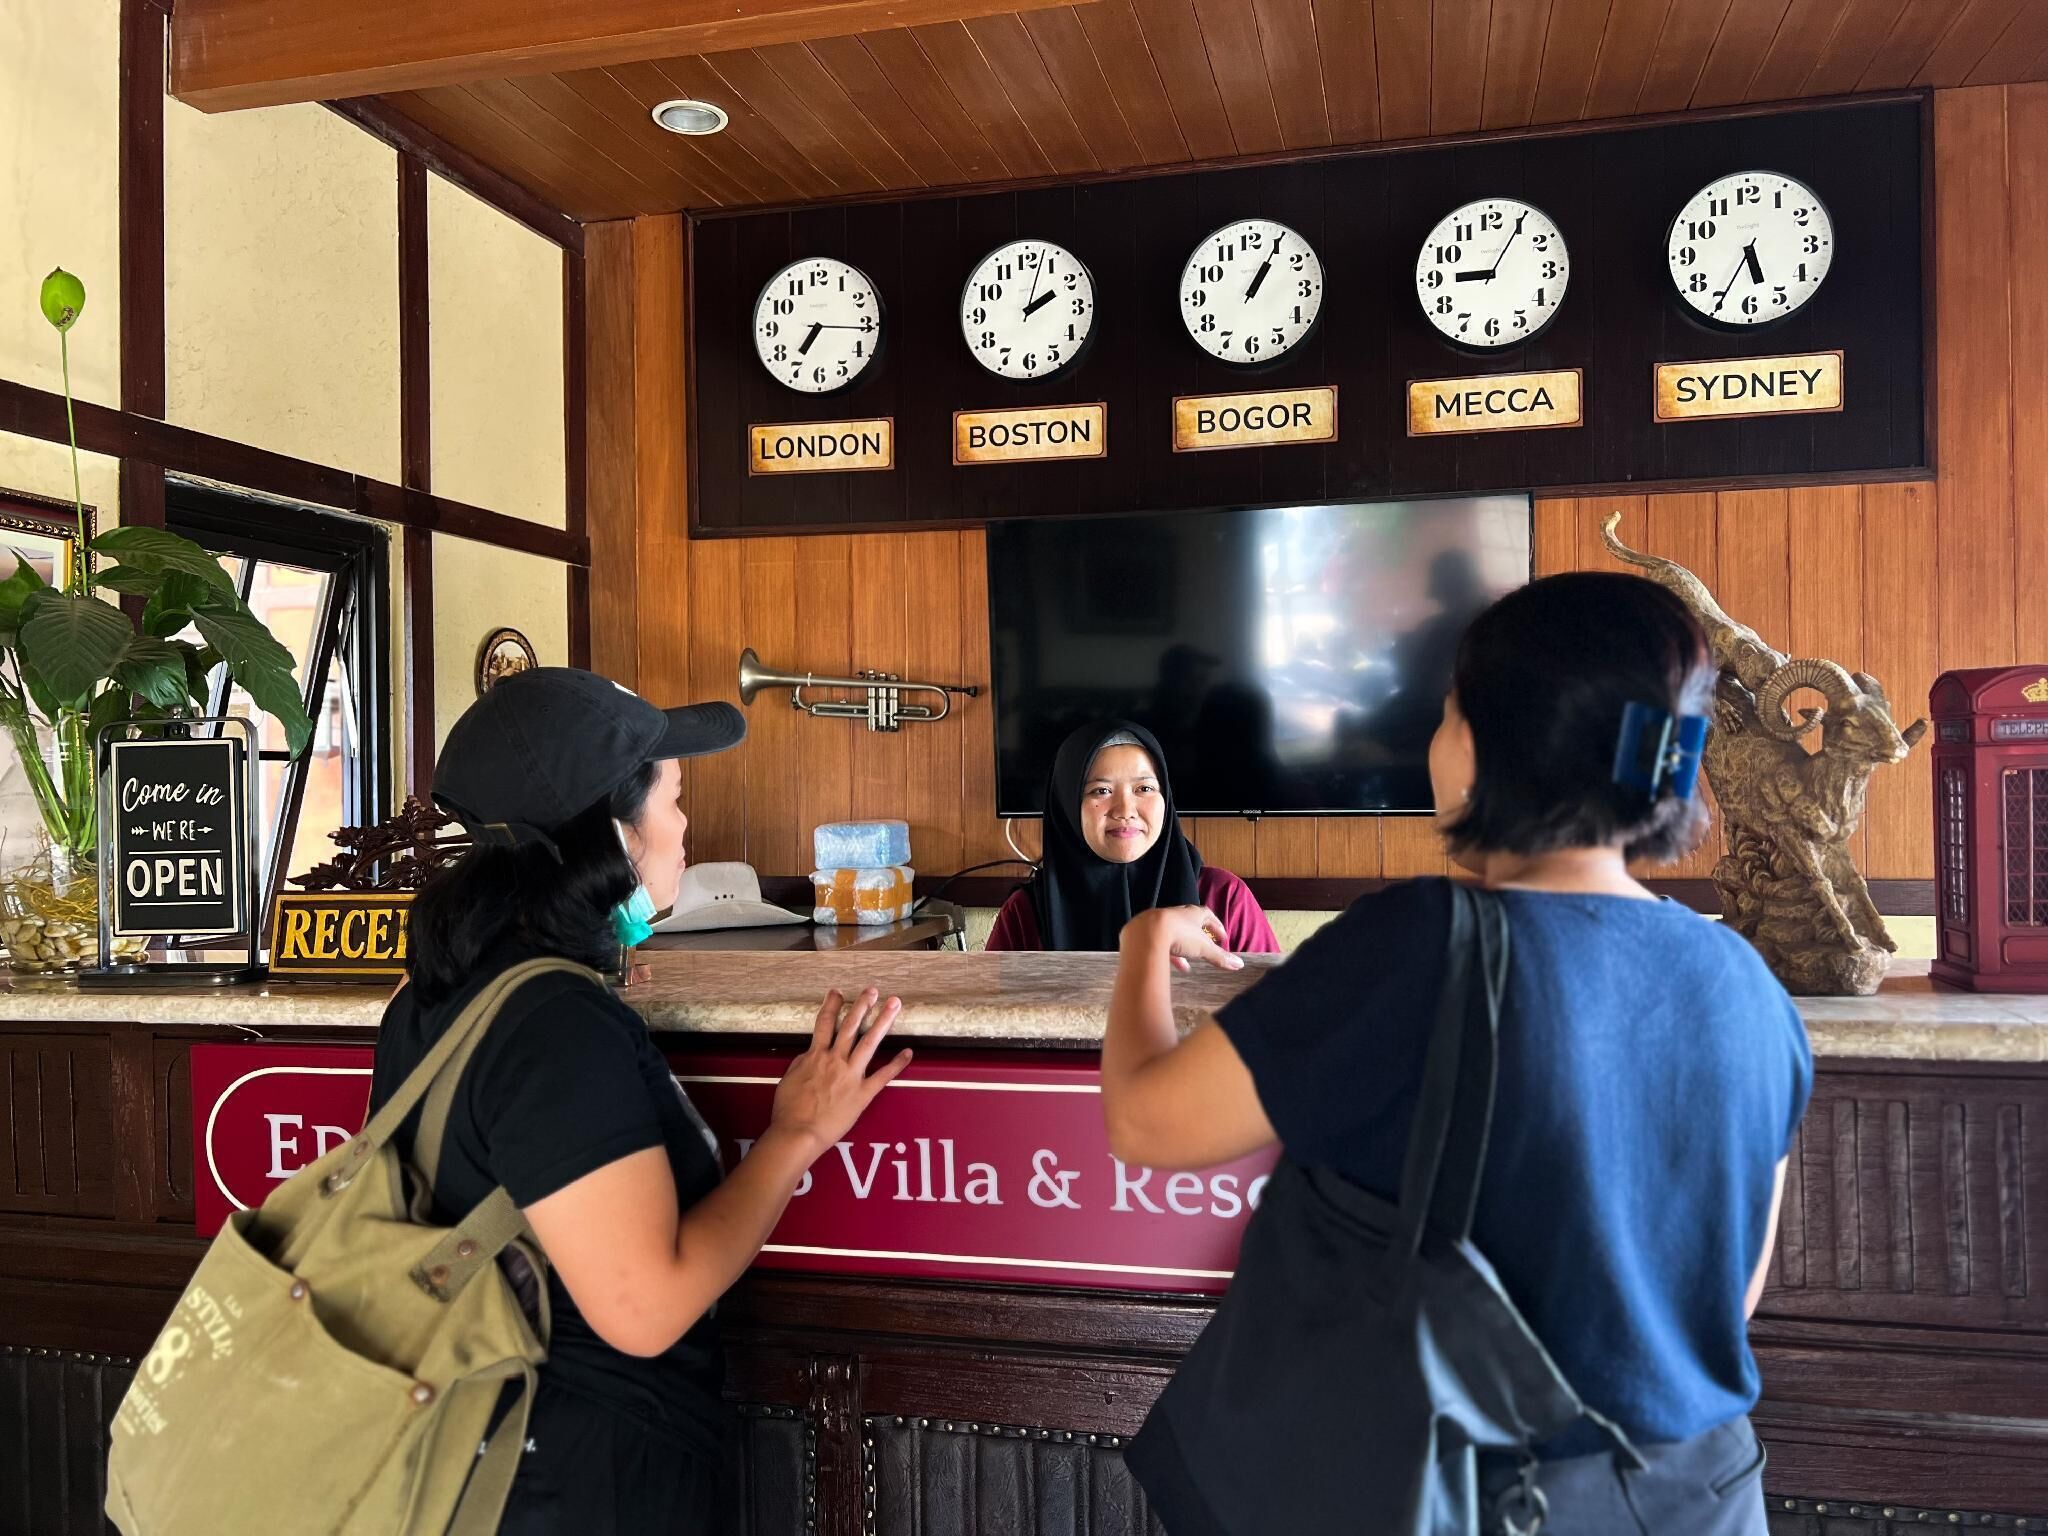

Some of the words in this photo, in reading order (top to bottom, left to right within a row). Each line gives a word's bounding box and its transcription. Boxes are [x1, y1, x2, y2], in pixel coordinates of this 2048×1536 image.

[1736, 185, 1761, 206] 12
[1774, 190, 1782, 209] 1
[1709, 198, 1728, 217] 11
[1480, 211, 1503, 231] 12
[1793, 208, 1809, 227] 2
[1455, 223, 1473, 242] 11
[1689, 220, 1716, 241] 10
[1240, 233, 1262, 251] 12
[1532, 234, 1548, 252] 2
[1803, 235, 1819, 254] 3
[1017, 252, 1038, 270] 12
[1218, 244, 1234, 262] 11
[1436, 244, 1462, 264] 10
[1679, 246, 1696, 266] 9
[997, 264, 1011, 280] 11
[1048, 258, 1054, 274] 1
[1289, 254, 1303, 272] 2
[1542, 261, 1557, 279] 3
[1792, 263, 1808, 282] 4
[809, 270, 829, 286] 12
[1063, 274, 1076, 290] 2
[1200, 264, 1224, 283] 10
[1427, 270, 1443, 289] 9
[1689, 272, 1708, 292] 8
[789, 280, 804, 296] 11
[839, 276, 844, 292] 1
[980, 284, 1002, 301] 10
[1298, 280, 1312, 297] 3
[852, 292, 865, 308] 2
[1192, 290, 1206, 307] 9
[1436, 295, 1453, 314] 8
[1531, 287, 1546, 306] 4
[1712, 291, 1726, 311] 7
[1772, 285, 1787, 305] 5
[773, 299, 794, 315] 10
[1072, 298, 1085, 316] 3
[1288, 305, 1303, 324] 4
[1741, 295, 1758, 315] 6
[860, 316, 872, 333] 3
[973, 307, 986, 325] 9
[1200, 314, 1216, 332] 8
[1457, 312, 1472, 333] 7
[1512, 309, 1527, 328] 5
[765, 321, 779, 337] 9
[1064, 324, 1075, 341] 4
[1270, 327, 1285, 345] 5
[1484, 317, 1500, 337] 6
[851, 340, 864, 358] 4
[981, 331, 996, 348] 8
[1220, 330, 1233, 350] 7
[1244, 336, 1260, 354] 6
[774, 344, 787, 361] 8
[1000, 347, 1012, 366] 7
[1022, 352, 1037, 370] 6
[1047, 344, 1060, 362] 5
[791, 361, 803, 379] 7
[813, 367, 826, 384] 6
[836, 360, 848, 377] 5
[1676, 368, 1822, 402] SYDNEY
[1435, 387, 1554, 418] MECCA
[1197, 403, 1312, 433] BOGOR
[969, 419, 1091, 448] BOSTON
[761, 432, 881, 460] LONDON
[122, 777, 190, 812] Come
[195, 783, 225, 807] in
[126, 858, 223, 898] OPEN
[834, 1137, 1003, 1206] Villa
[1027, 1148, 1082, 1210] &
[184, 1285, 233, 1360] STYLE
[147, 1326, 190, 1384] 8
